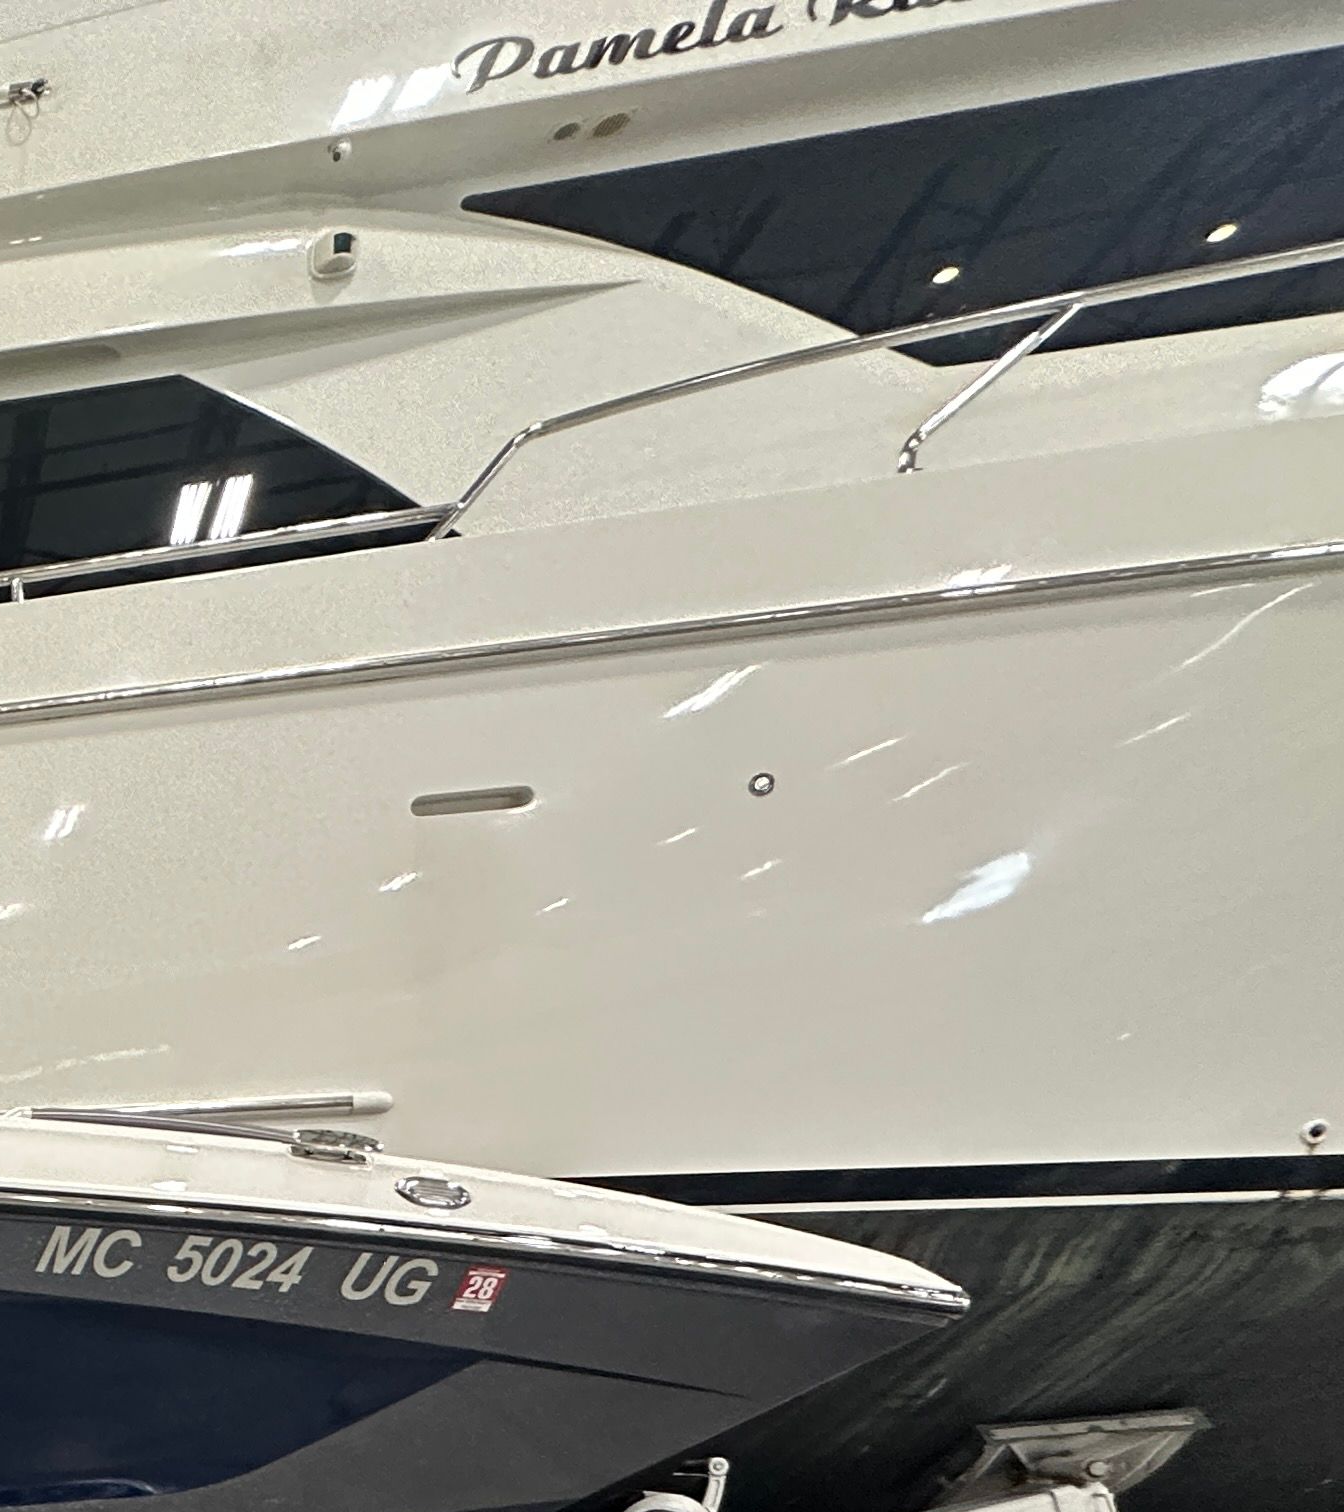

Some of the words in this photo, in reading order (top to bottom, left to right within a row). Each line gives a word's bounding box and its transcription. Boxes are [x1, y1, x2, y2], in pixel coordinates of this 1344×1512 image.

[451, 0, 785, 95] Pamela
[35, 1225, 142, 1277] MC
[165, 1235, 315, 1292] 5024
[339, 1251, 439, 1306] UG
[462, 1276, 499, 1300] 28
